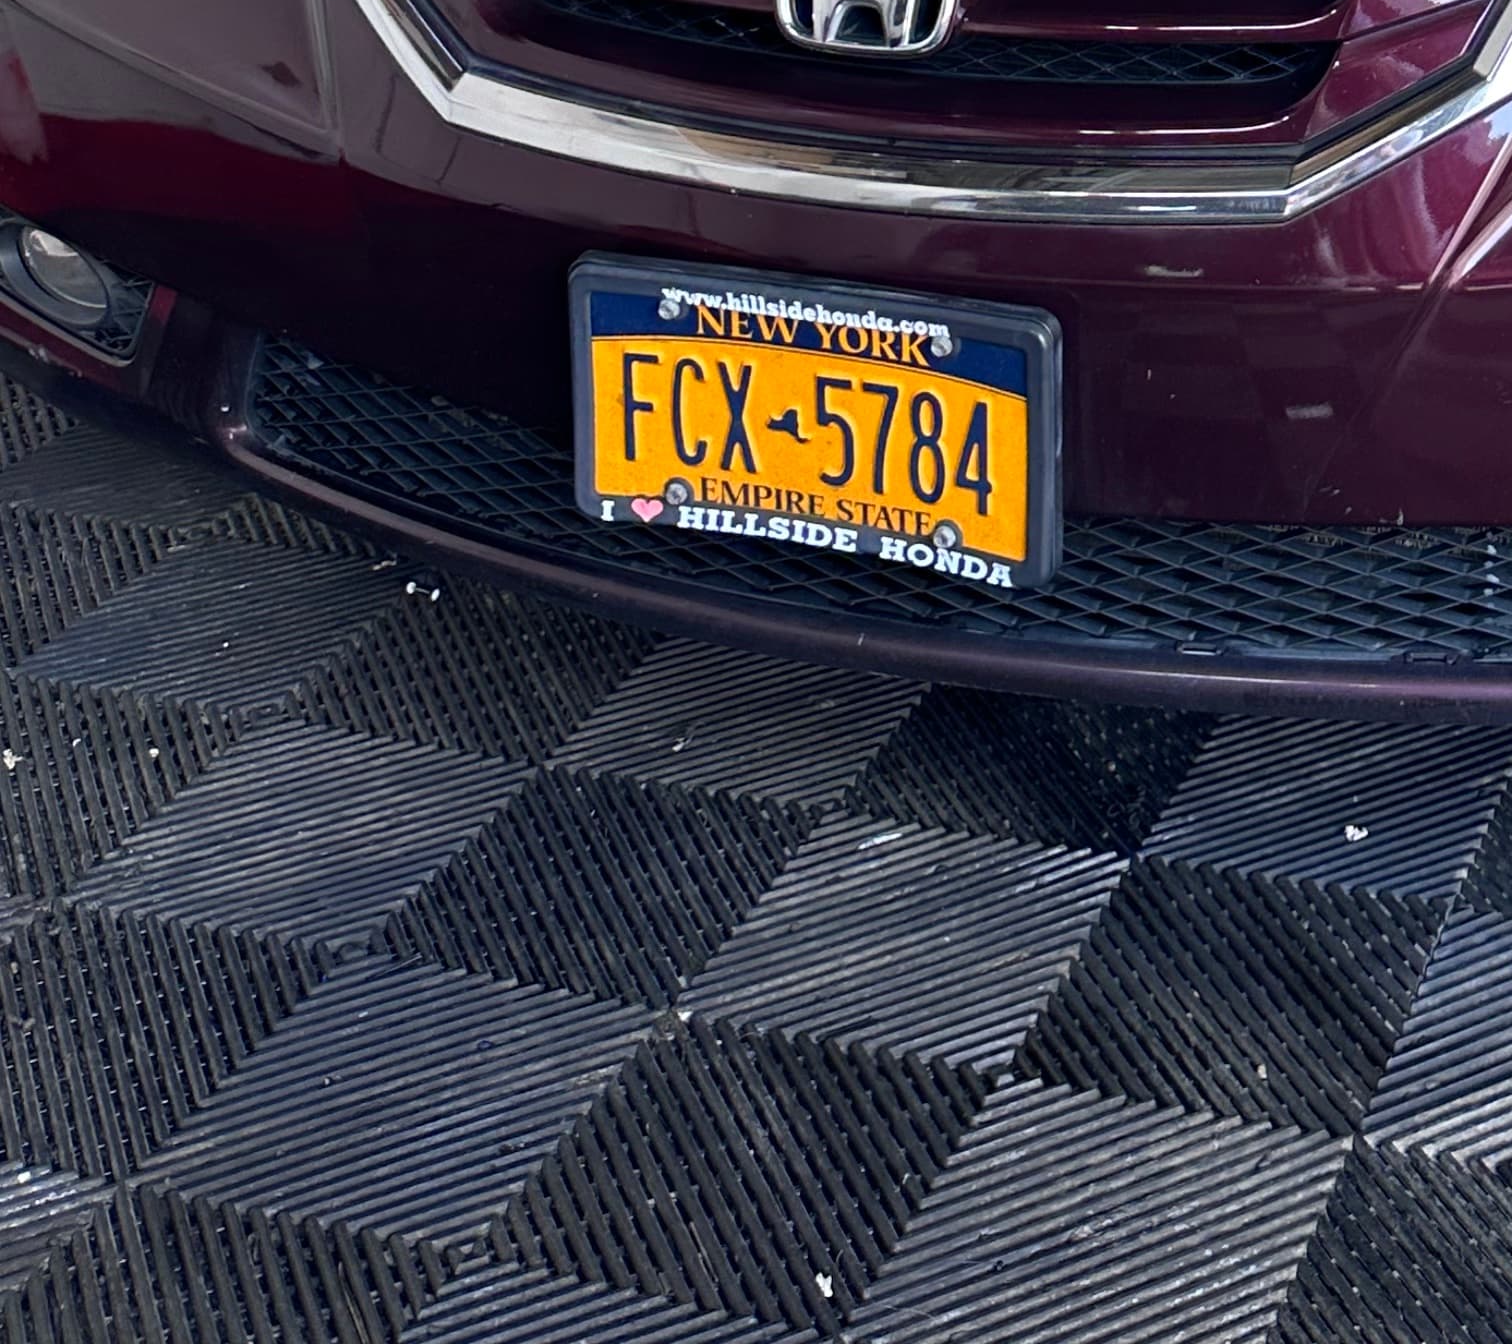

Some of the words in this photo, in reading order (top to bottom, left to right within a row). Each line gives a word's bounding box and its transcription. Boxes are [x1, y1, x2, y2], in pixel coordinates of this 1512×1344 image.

[661, 287, 950, 338] www.hillsidehonda.com
[696, 303, 800, 344] NEW
[814, 321, 930, 367] YORK
[622, 351, 757, 474] FCX
[815, 374, 993, 516] 5784
[700, 475, 826, 519] EMPIRE
[835, 497, 932, 538] STATE
[600, 499, 616, 522] I
[676, 505, 859, 553] HILLSIDE
[878, 535, 1014, 588] HONDA
